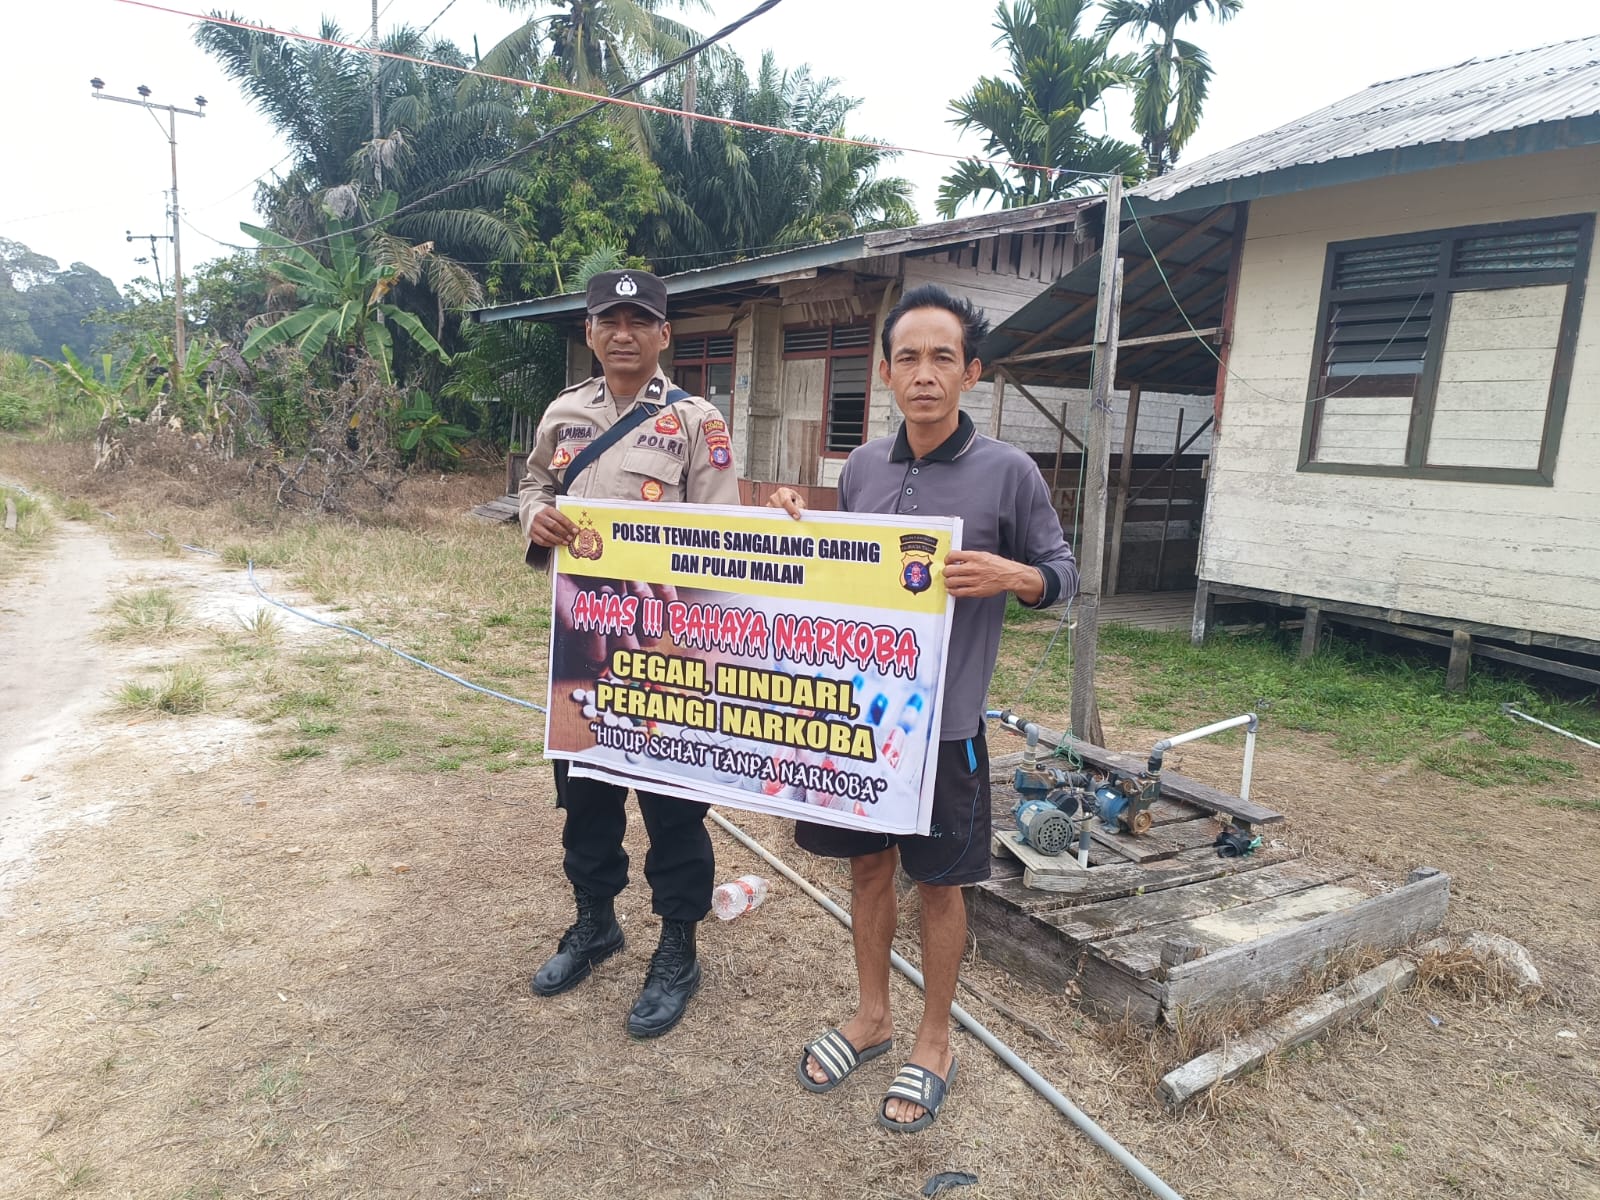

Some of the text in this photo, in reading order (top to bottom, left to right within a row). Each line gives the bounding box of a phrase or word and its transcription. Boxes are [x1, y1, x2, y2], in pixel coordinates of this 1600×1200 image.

[637, 434, 683, 455] POLRI
[612, 522, 661, 544] POLSEK
[663, 526, 720, 550] TEWANG
[723, 531, 814, 558] SANGALANG
[818, 538, 881, 563] GARING
[671, 553, 804, 584] DAN PULAU MALAN
[573, 590, 639, 637] AWAS
[667, 601, 768, 658] BAHAYA
[774, 614, 919, 679] NARKOBA
[612, 650, 858, 717] CEGAH, HINDARI,
[597, 684, 874, 760] PERANGI NARKOBA
[649, 736, 708, 766] SEHAT
[713, 748, 777, 781] TANPA
